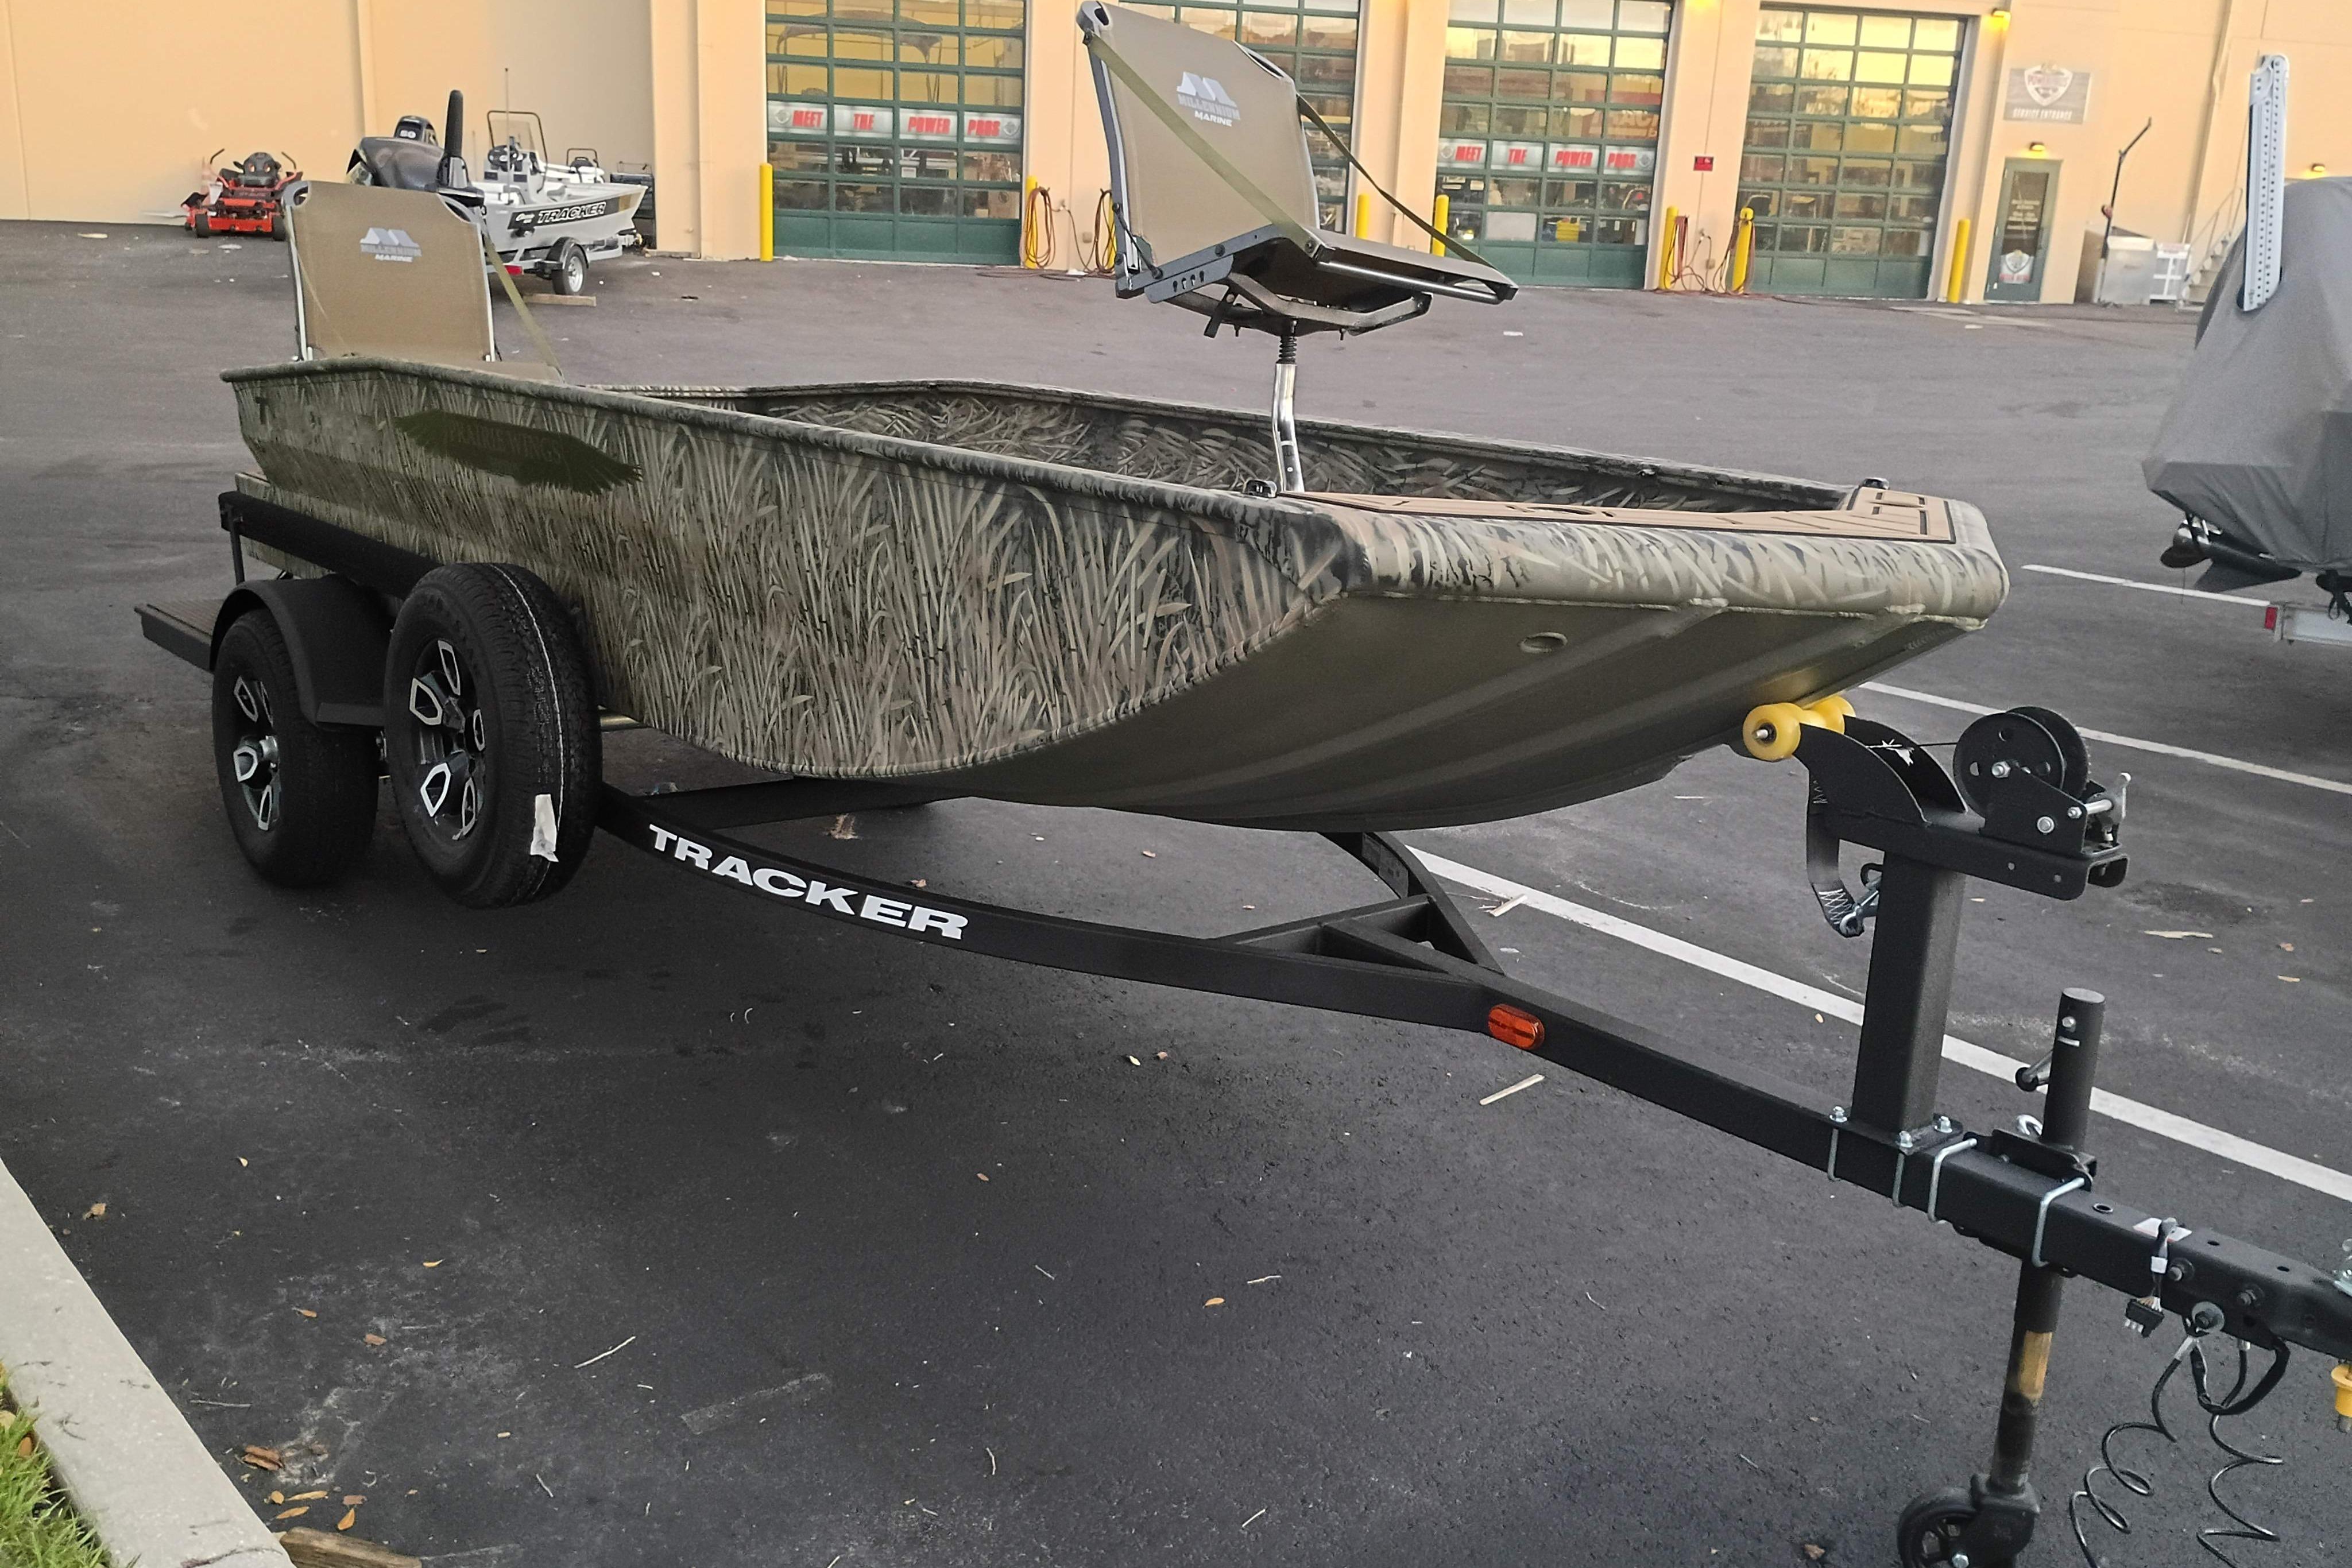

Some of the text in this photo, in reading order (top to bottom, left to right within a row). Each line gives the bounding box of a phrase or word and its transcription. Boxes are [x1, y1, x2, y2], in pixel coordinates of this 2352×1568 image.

[792, 110, 823, 127] MEET
[853, 113, 875, 131] THE
[907, 116, 950, 134] POWER
[1194, 110, 1232, 127] MARINE
[1454, 146, 1483, 162] MEET
[1508, 148, 1528, 165] THE
[1555, 150, 1593, 167] POWER
[537, 202, 606, 223] TRACKER
[649, 824, 969, 940] TRACKER
